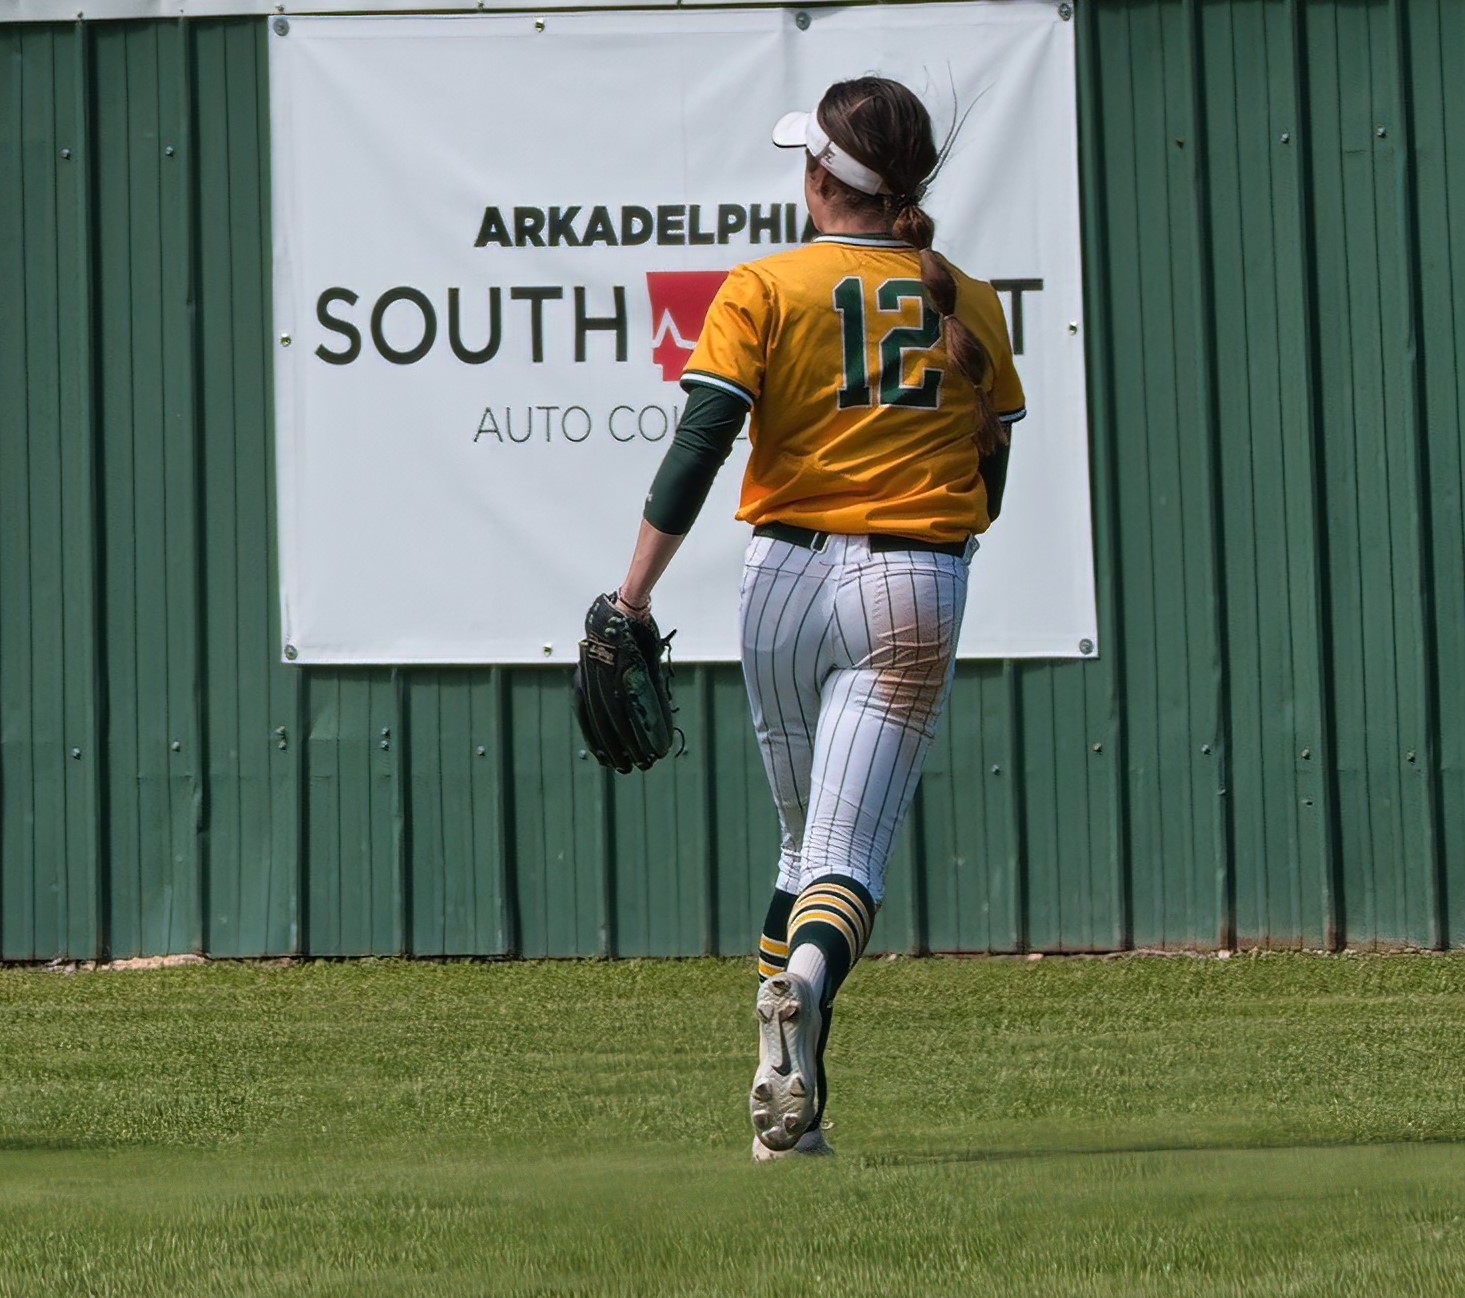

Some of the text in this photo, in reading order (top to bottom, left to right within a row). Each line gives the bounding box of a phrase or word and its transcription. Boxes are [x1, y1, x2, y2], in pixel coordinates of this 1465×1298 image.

[314, 286, 628, 366] SOUTH
[833, 276, 945, 411] 12
[473, 405, 592, 443] AUTO
